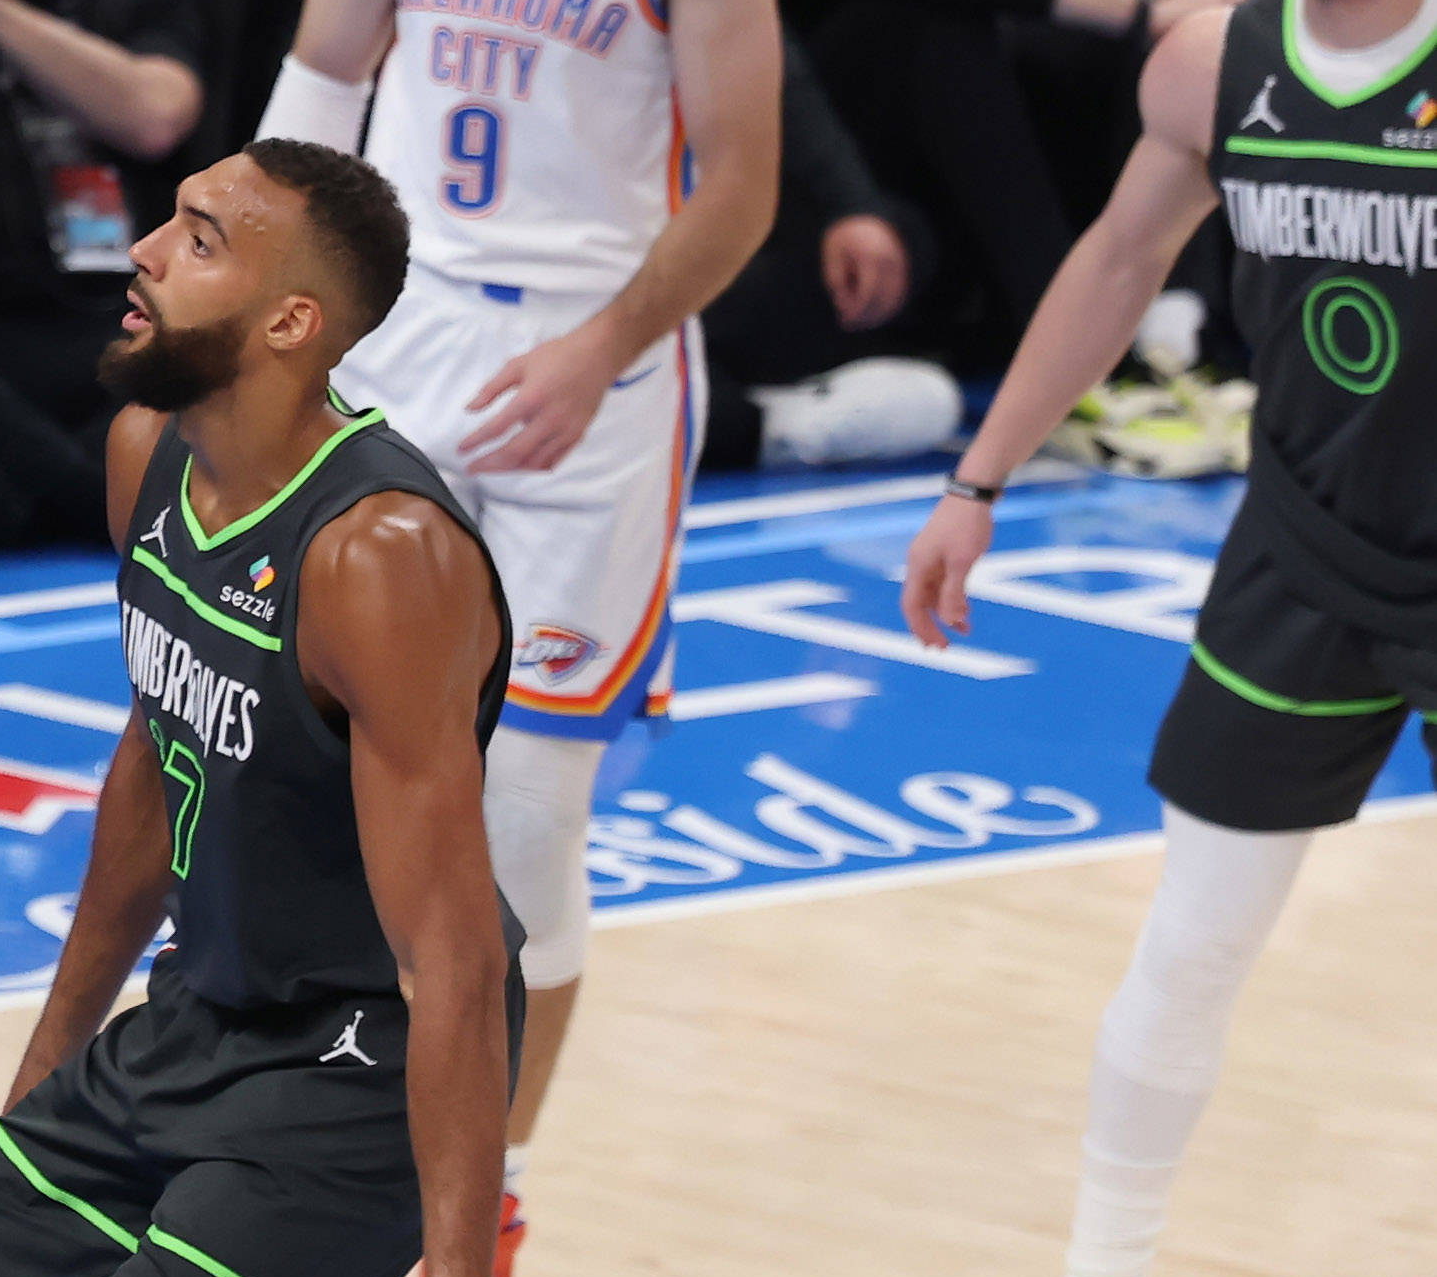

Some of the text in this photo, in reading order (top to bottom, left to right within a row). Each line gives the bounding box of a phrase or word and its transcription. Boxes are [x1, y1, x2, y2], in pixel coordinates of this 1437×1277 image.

[427, 25, 543, 102] CITY
[437, 103, 510, 221] 9
[1302, 275, 1401, 396] 0
[219, 583, 276, 623] sezzle
